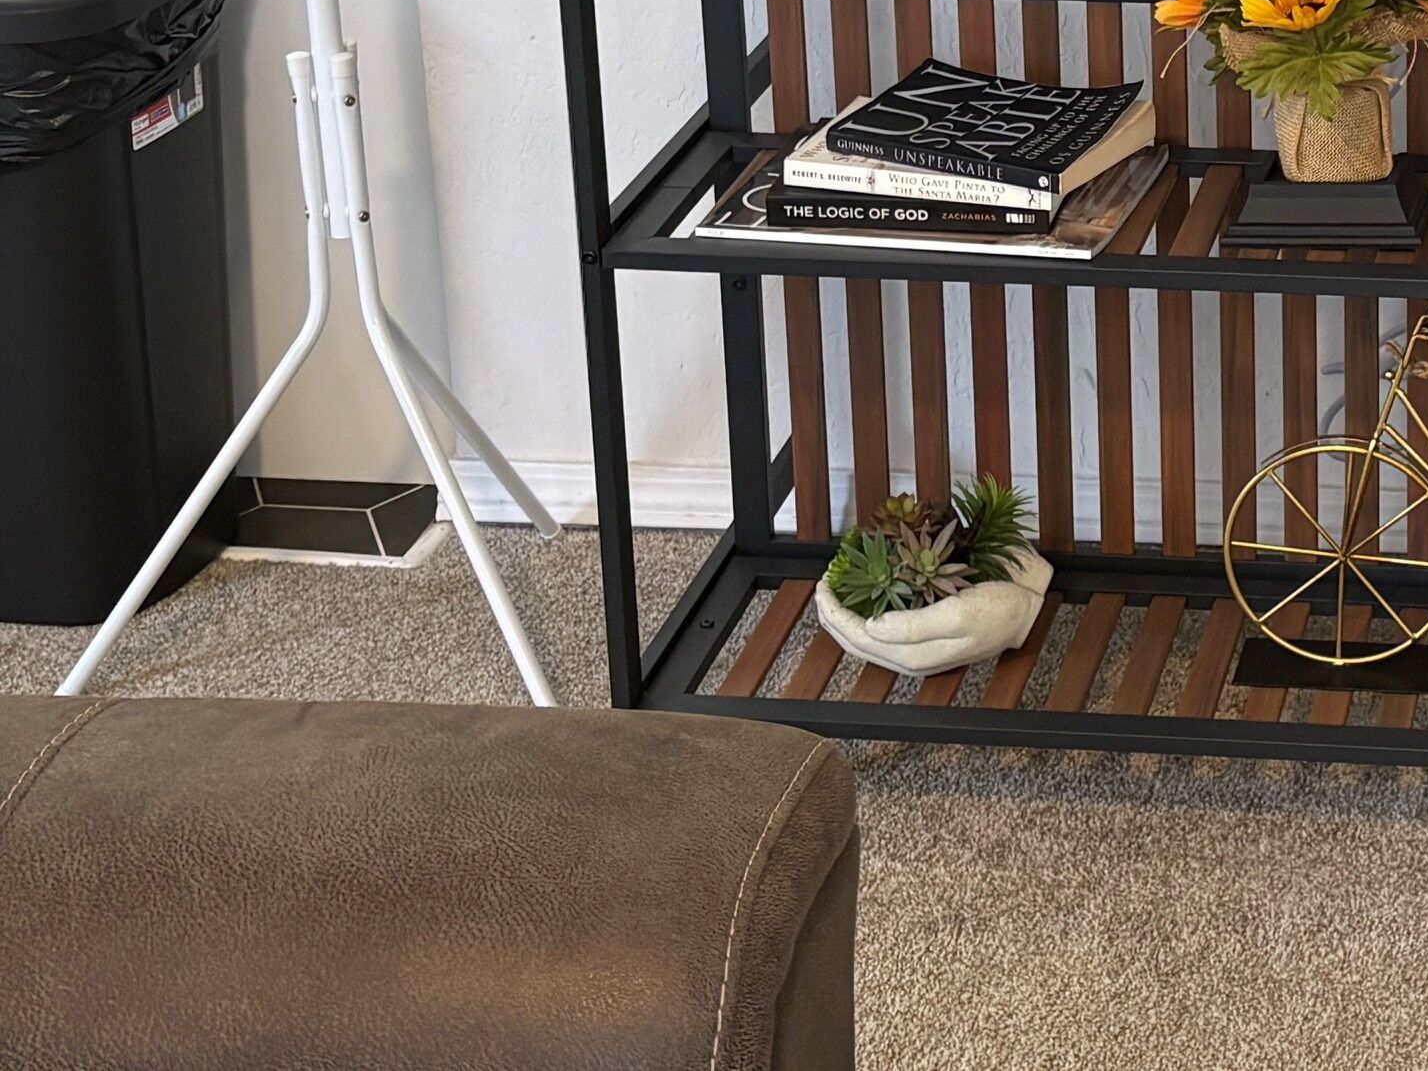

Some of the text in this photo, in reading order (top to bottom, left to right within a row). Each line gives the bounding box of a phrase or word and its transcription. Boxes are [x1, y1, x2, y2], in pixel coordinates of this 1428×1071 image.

[838, 64, 991, 136] UN
[909, 79, 1038, 149] SPEAK
[1058, 111, 1077, 123] TO
[955, 87, 1082, 162] ABLE
[837, 138, 884, 156] GUINNESS
[894, 147, 1004, 180] UNSPEAKABLE
[889, 173, 1006, 194] WHO GAVE PINTA TO
[893, 185, 912, 195] THE
[918, 188, 952, 200] SANTA
[784, 205, 929, 221] THE LOGIC OF GOD
[941, 212, 998, 222] ZACHARIAS
